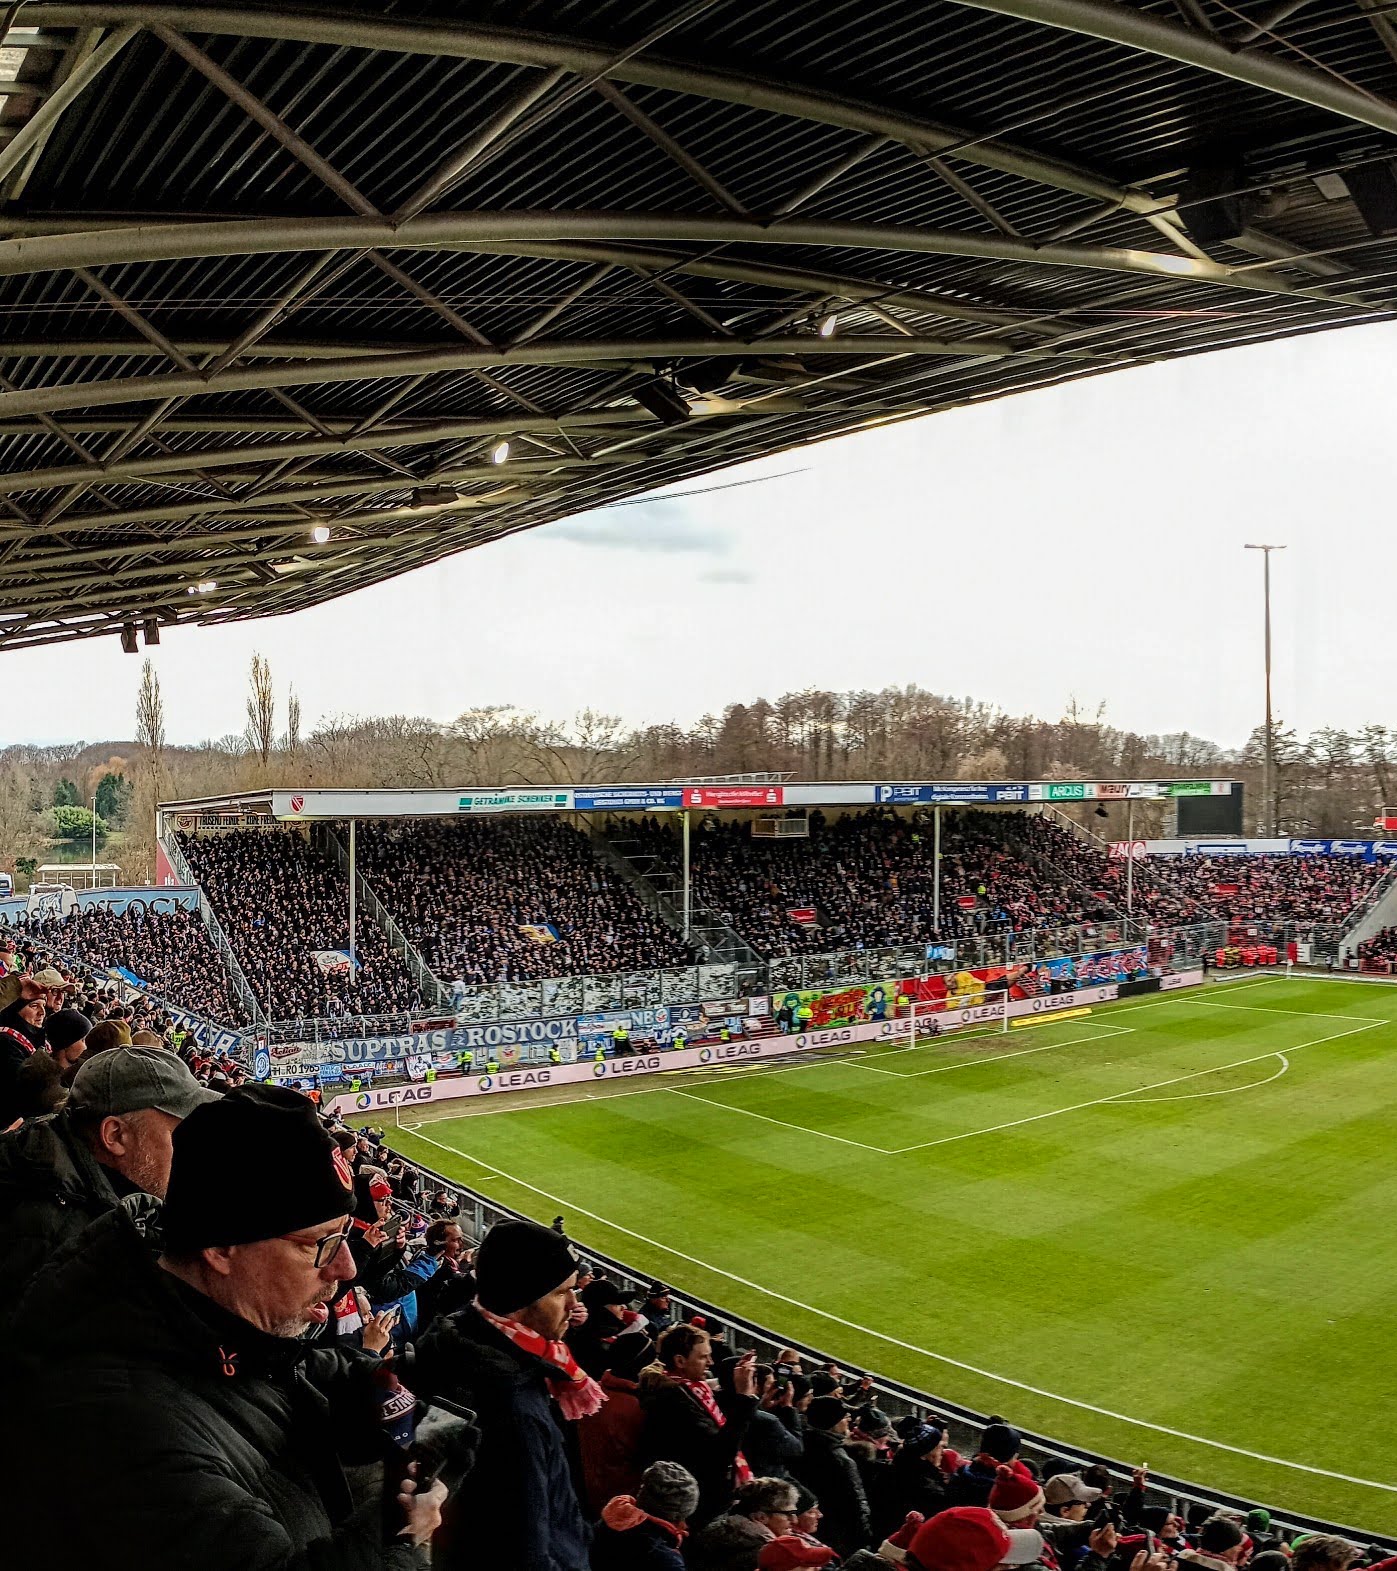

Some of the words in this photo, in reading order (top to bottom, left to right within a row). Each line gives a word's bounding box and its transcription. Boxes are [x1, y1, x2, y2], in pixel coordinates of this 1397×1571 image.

[1052, 784, 1083, 797] ARCUS
[1044, 995, 1074, 1008] LEAG
[973, 1006, 1005, 1020] LEAG
[332, 1033, 447, 1062] SUPTRAS
[466, 1018, 577, 1047] ROSTOCK
[811, 1031, 851, 1045] LEAG
[716, 1043, 761, 1059] LEAG
[612, 1057, 660, 1074] LEAG
[499, 1071, 550, 1087] LEAG
[377, 1086, 432, 1105] LEAG
